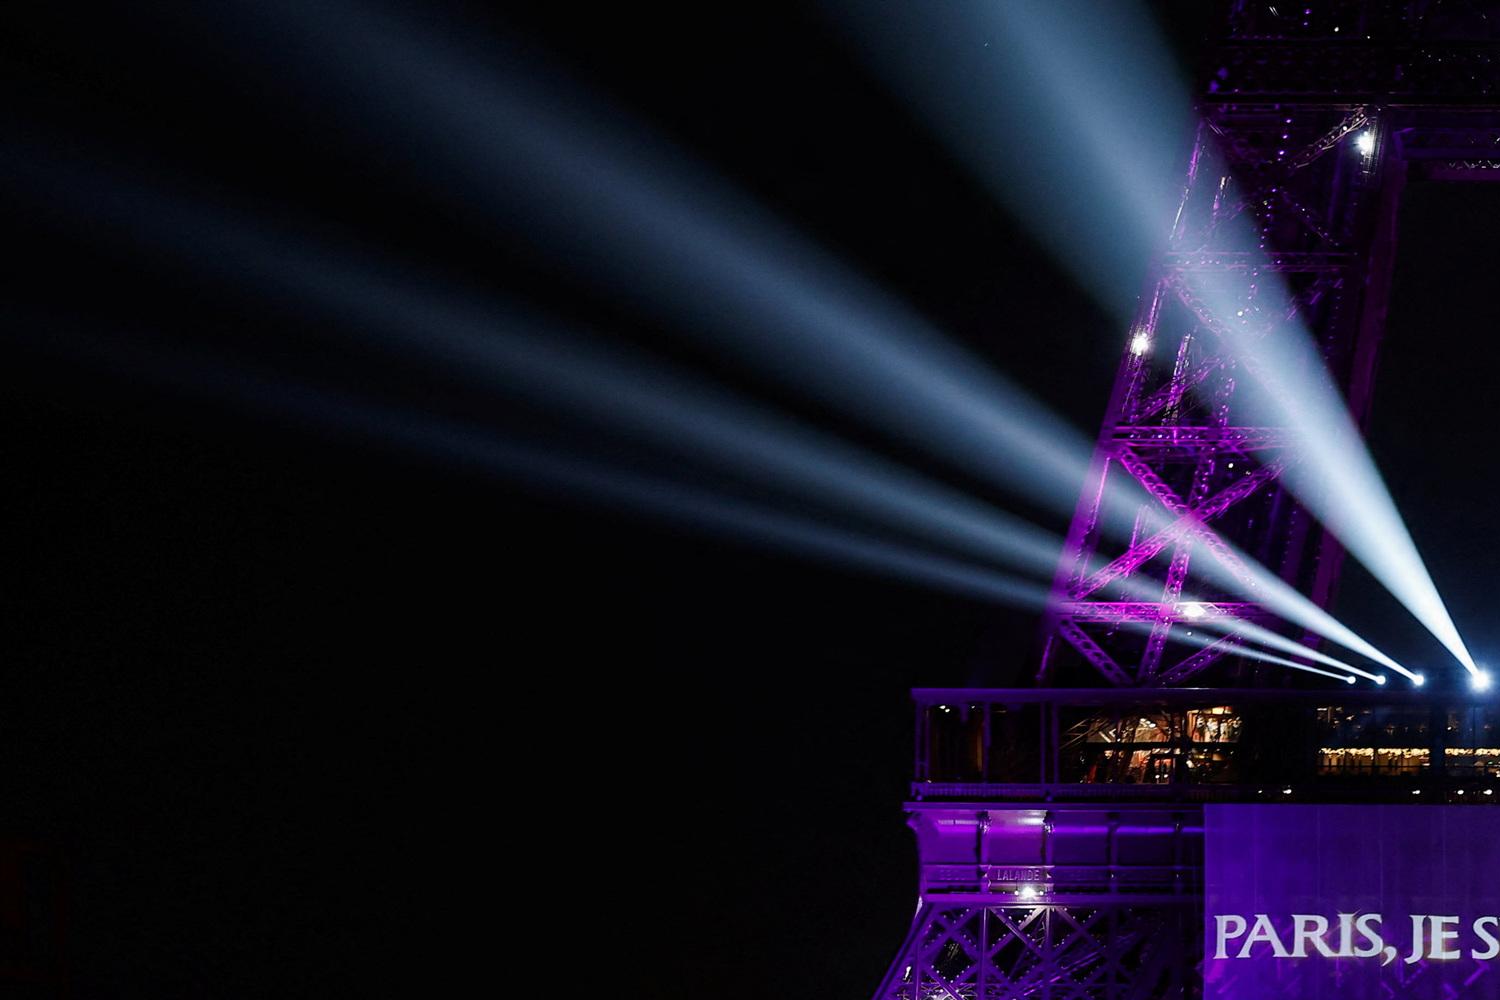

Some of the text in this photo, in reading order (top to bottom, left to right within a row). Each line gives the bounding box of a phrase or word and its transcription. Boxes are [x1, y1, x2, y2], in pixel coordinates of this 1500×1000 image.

[996, 869, 1040, 881] LALANDE
[1212, 912, 1396, 966] PARIS,
[1404, 914, 1460, 964] JE
